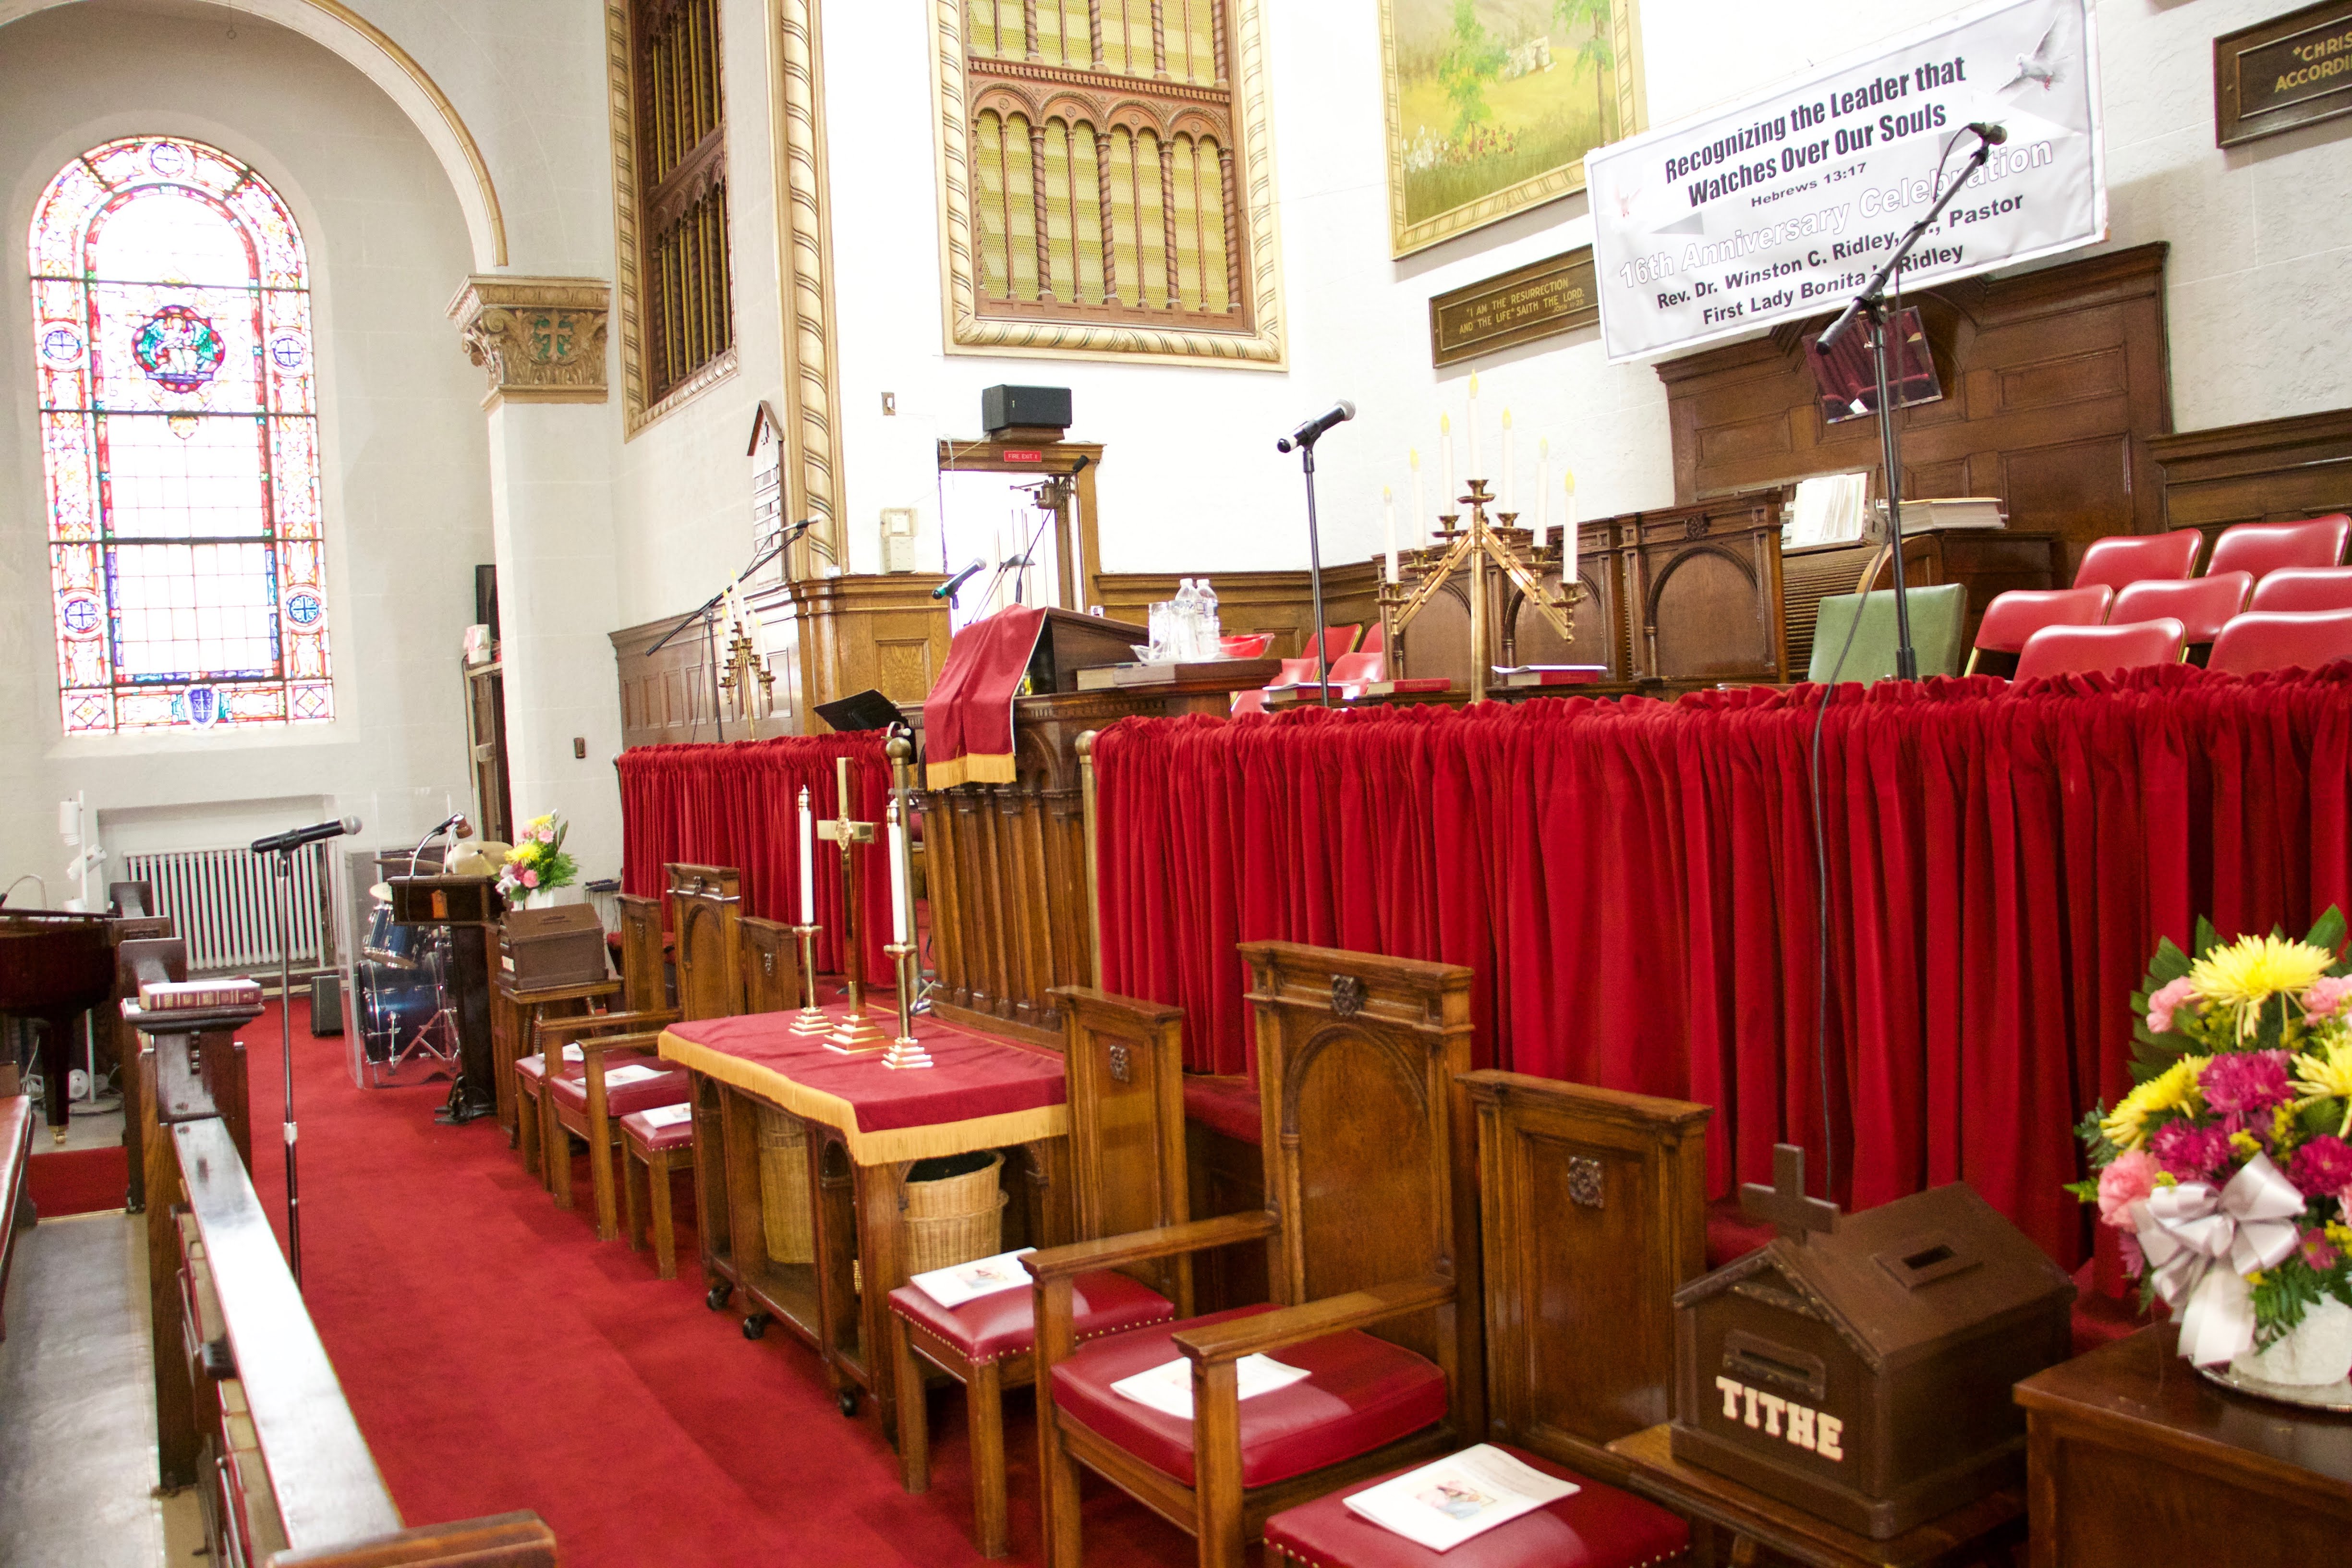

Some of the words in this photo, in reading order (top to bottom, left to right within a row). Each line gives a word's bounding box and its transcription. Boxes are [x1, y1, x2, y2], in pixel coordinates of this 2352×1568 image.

[2274, 54, 2352, 93] ACCORDI
[1665, 116, 1786, 184] Recognizing
[1790, 104, 1825, 132] the
[1830, 73, 1909, 119] Leader
[1915, 56, 1966, 92] that
[1688, 158, 1777, 207] Watches
[1781, 138, 1830, 173] Over
[1834, 123, 1874, 155] Our
[1879, 103, 1946, 142] Souls
[1751, 179, 1818, 207] Hebrews
[1823, 162, 1867, 184] 13:17
[1620, 252, 1674, 289] 16th
[1681, 202, 1850, 271] Anniversary
[1657, 291, 1691, 309] Rev.
[1695, 281, 1718, 298] Dr.
[1725, 259, 1802, 289] Winston
[1807, 250, 1827, 267] C.
[1832, 231, 1899, 261] Ridley,
[1950, 194, 2023, 228] Pastor
[1703, 301, 1743, 324] First
[1750, 289, 1794, 312] Lady
[1801, 272, 1866, 299] Bonita
[1899, 244, 1964, 274] Ridley
[1459, 322, 1473, 335] AND
[1477, 315, 1492, 329] THE
[1516, 301, 1539, 317] SAITH
[1543, 294, 1559, 308] THE
[1476, 304, 1488, 316] AM
[1492, 297, 1507, 310] THE
[1511, 277, 1569, 304] RESURRECTION
[1715, 1375, 1843, 1462] TITHE
